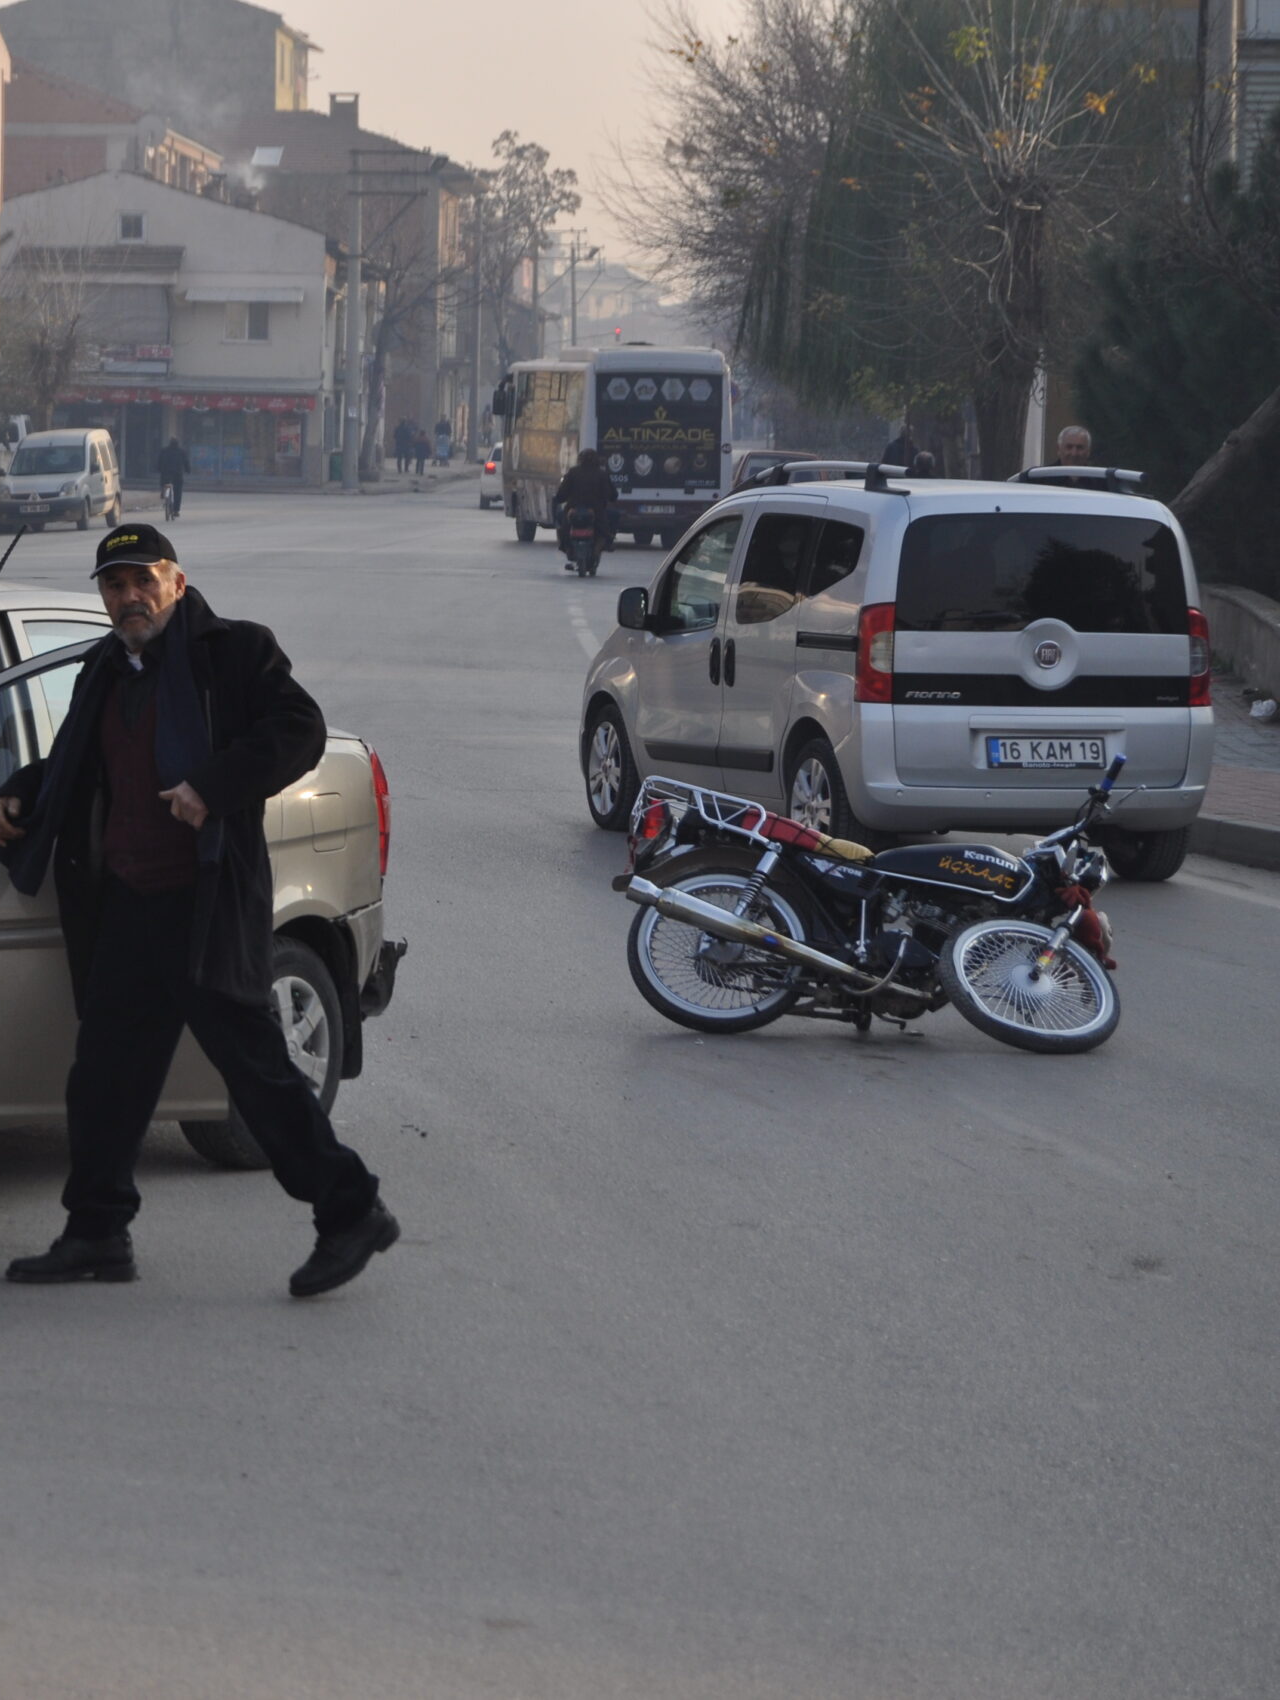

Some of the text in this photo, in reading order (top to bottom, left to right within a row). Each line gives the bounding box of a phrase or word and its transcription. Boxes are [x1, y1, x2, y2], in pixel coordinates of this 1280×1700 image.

[603, 427, 716, 441] ALTINZADE
[1000, 741, 1100, 760] 16 KAM 19
[964, 849, 1019, 873] Kanuni
